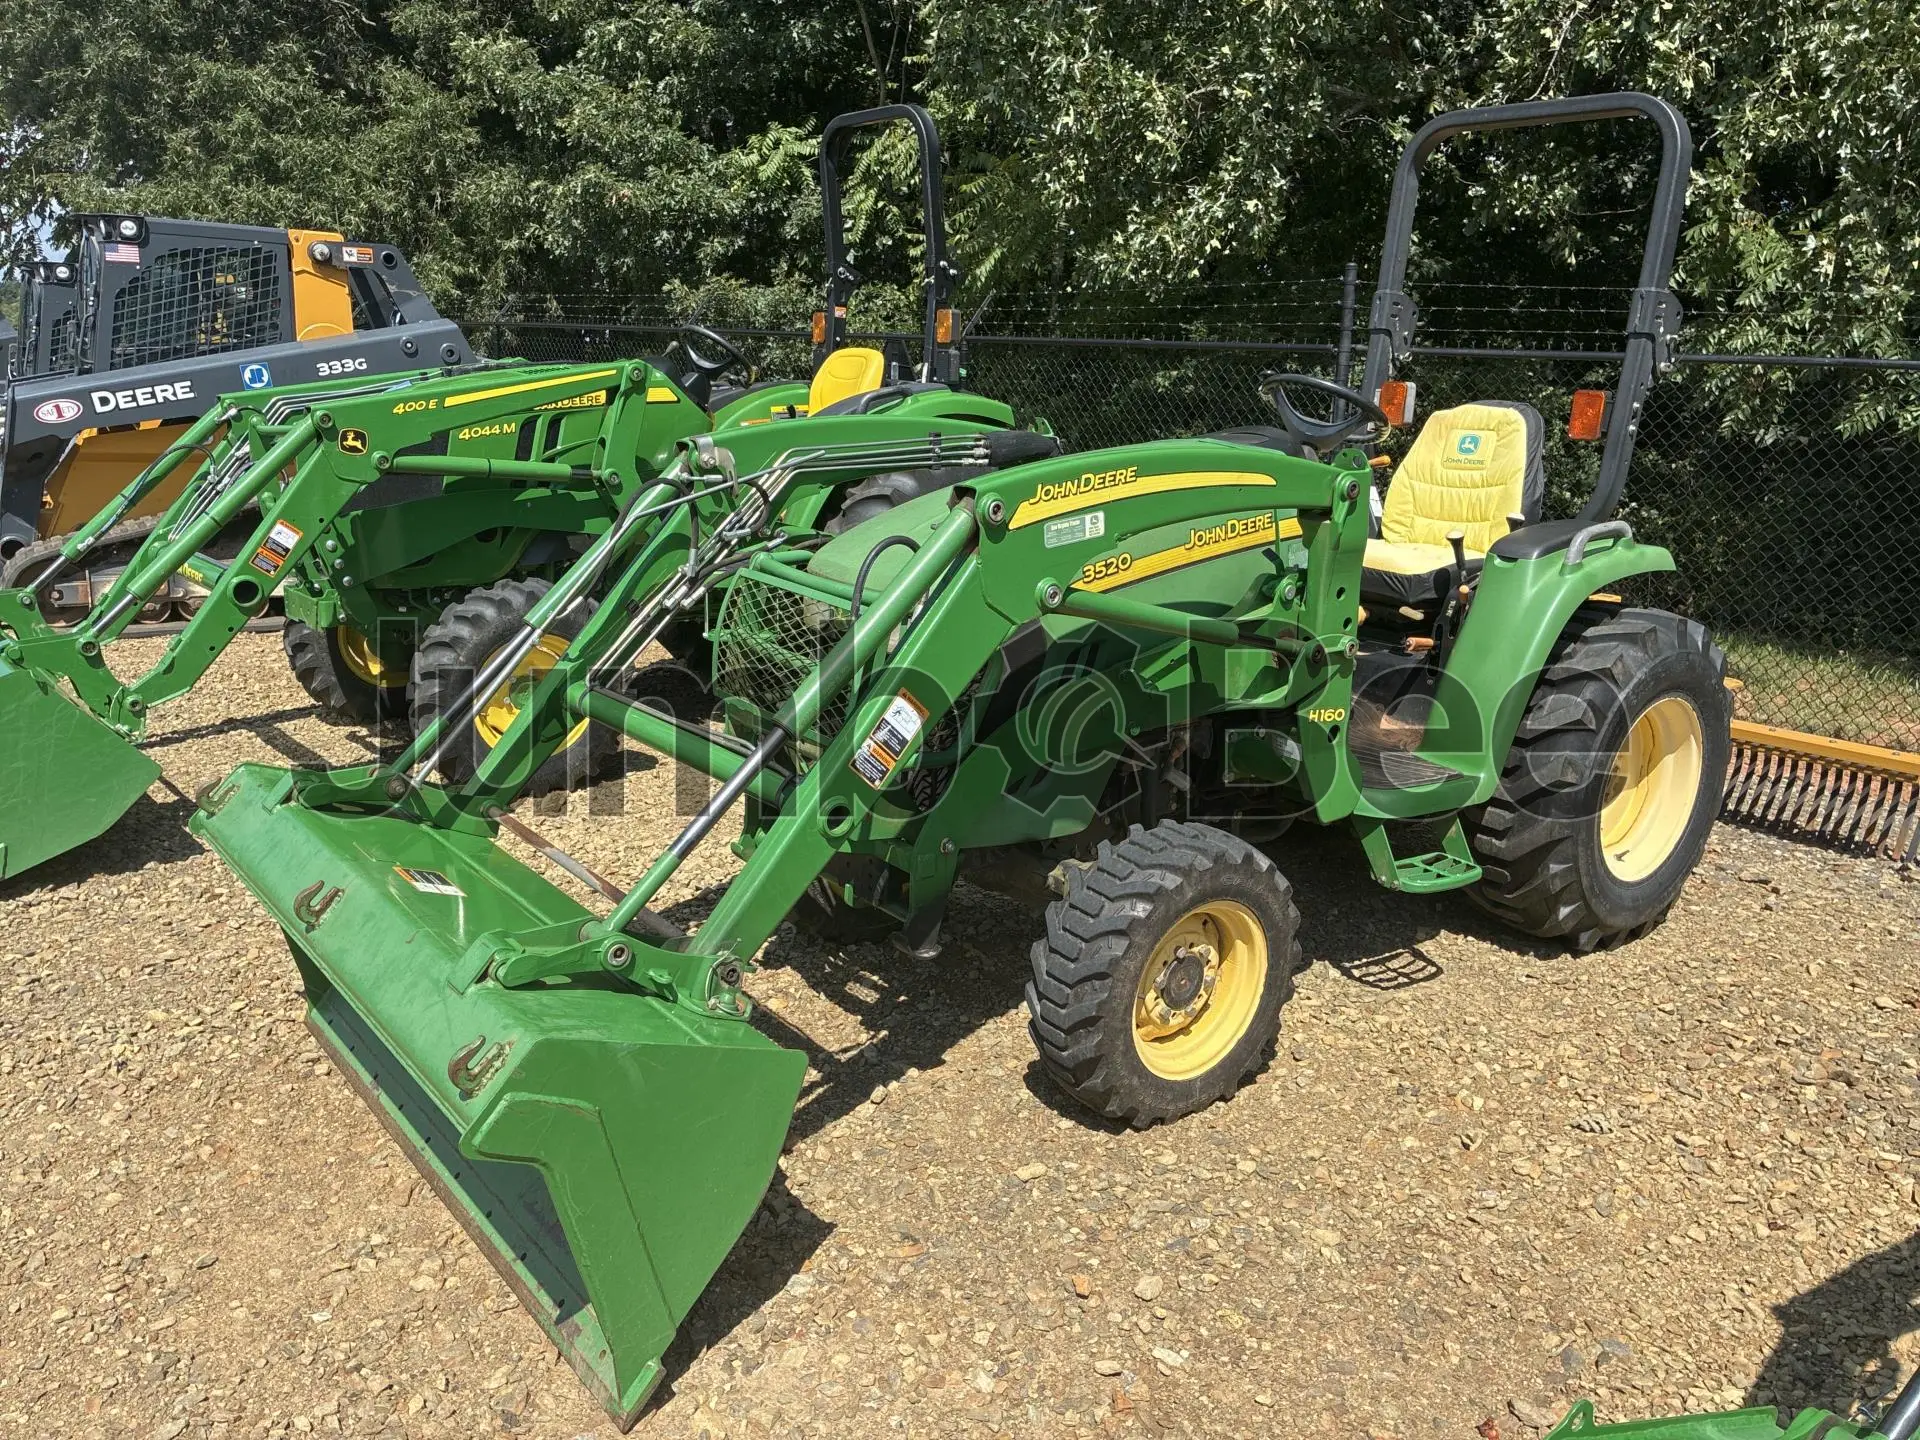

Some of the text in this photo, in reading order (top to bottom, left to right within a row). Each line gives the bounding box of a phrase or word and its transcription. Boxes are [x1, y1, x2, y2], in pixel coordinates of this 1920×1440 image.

[316, 358, 368, 376] 333G
[90, 380, 195, 414] DEERE
[392, 398, 439, 415] 400 E
[458, 422, 516, 441] 4044 M
[1443, 456, 1486, 466] JOHN DEERE
[1028, 465, 1138, 505] JOHN DEERE
[1184, 512, 1274, 551] JOHN DEERE
[1082, 551, 1133, 584] 3520
[1309, 708, 1345, 723] H160
